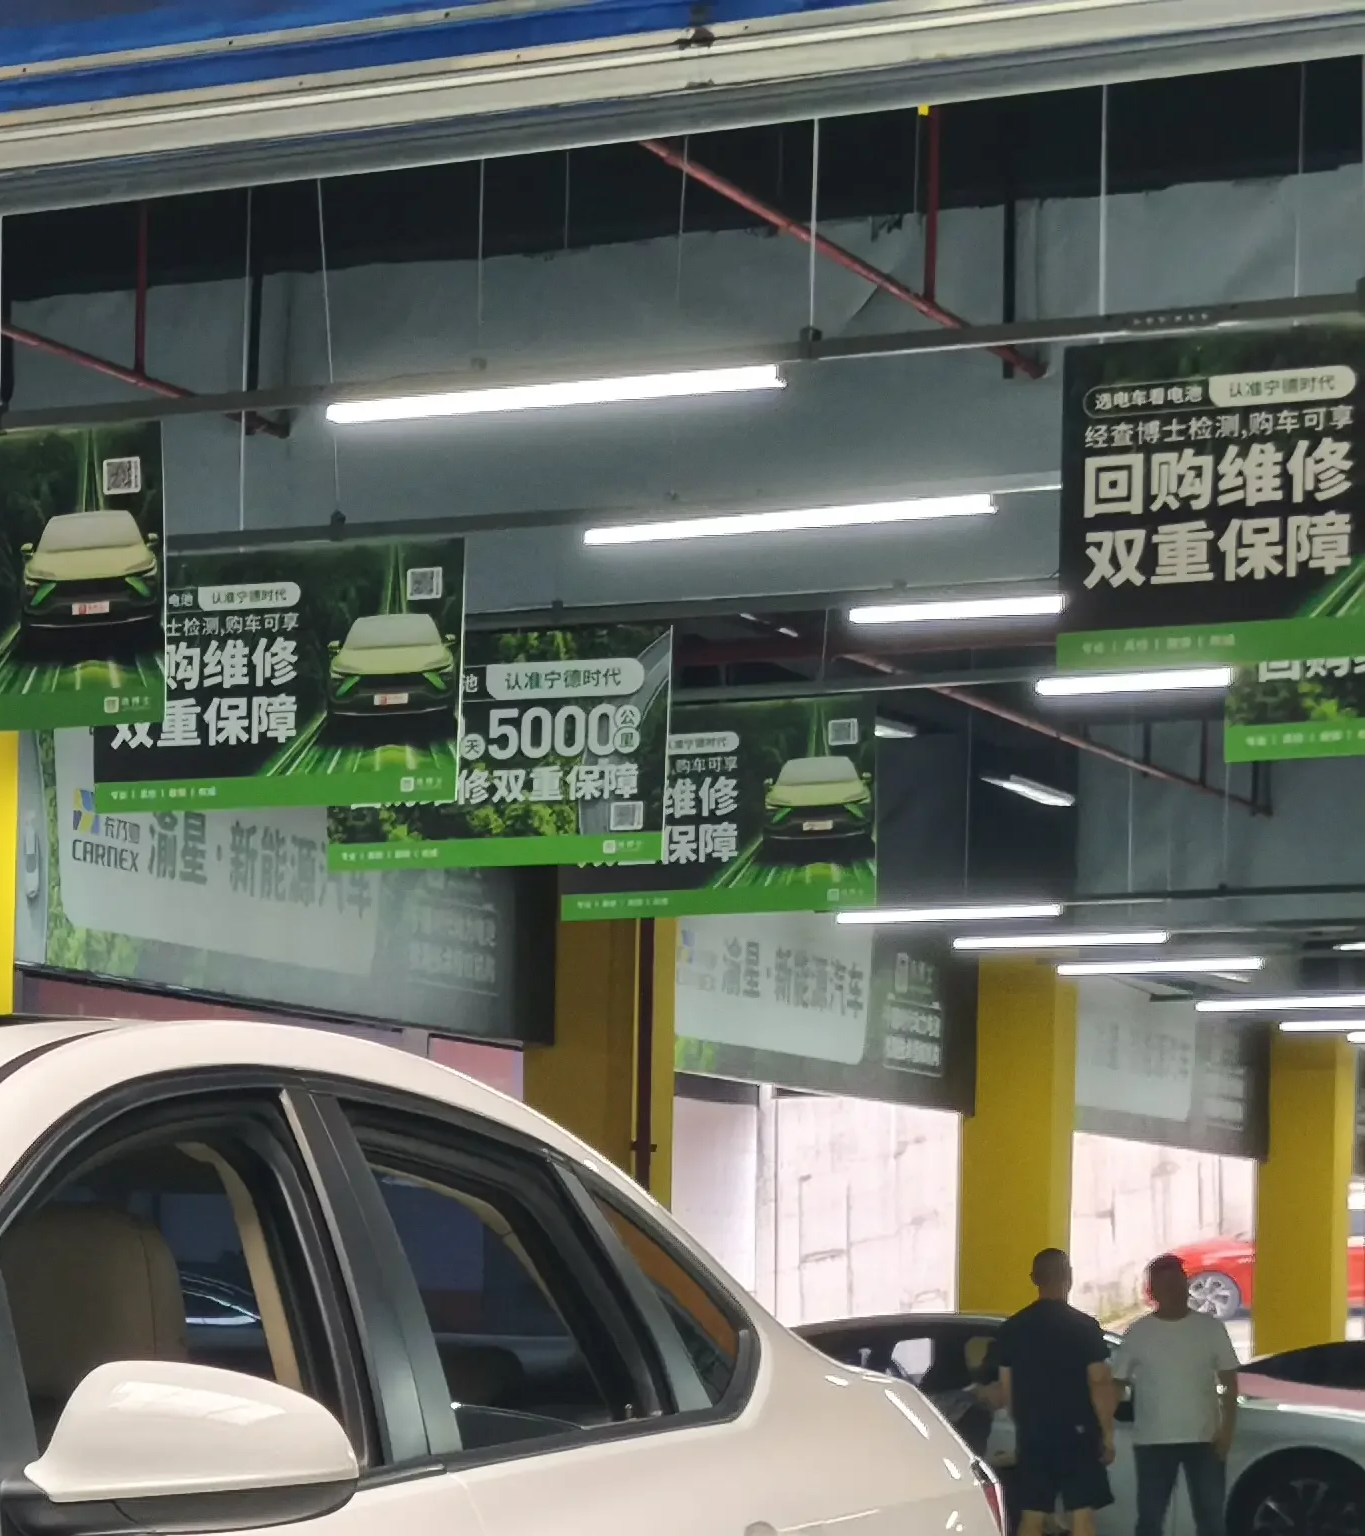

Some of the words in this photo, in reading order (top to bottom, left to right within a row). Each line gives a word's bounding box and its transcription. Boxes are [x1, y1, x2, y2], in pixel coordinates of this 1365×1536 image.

[1084, 405, 1354, 448] 经查博士检测,购车可享
[1083, 437, 1354, 518] 回购维修
[1083, 510, 1353, 590] 双重保障
[505, 668, 622, 691] 认准宁德时代
[488, 703, 617, 760] 5000
[72, 838, 139, 873] CARNEX
